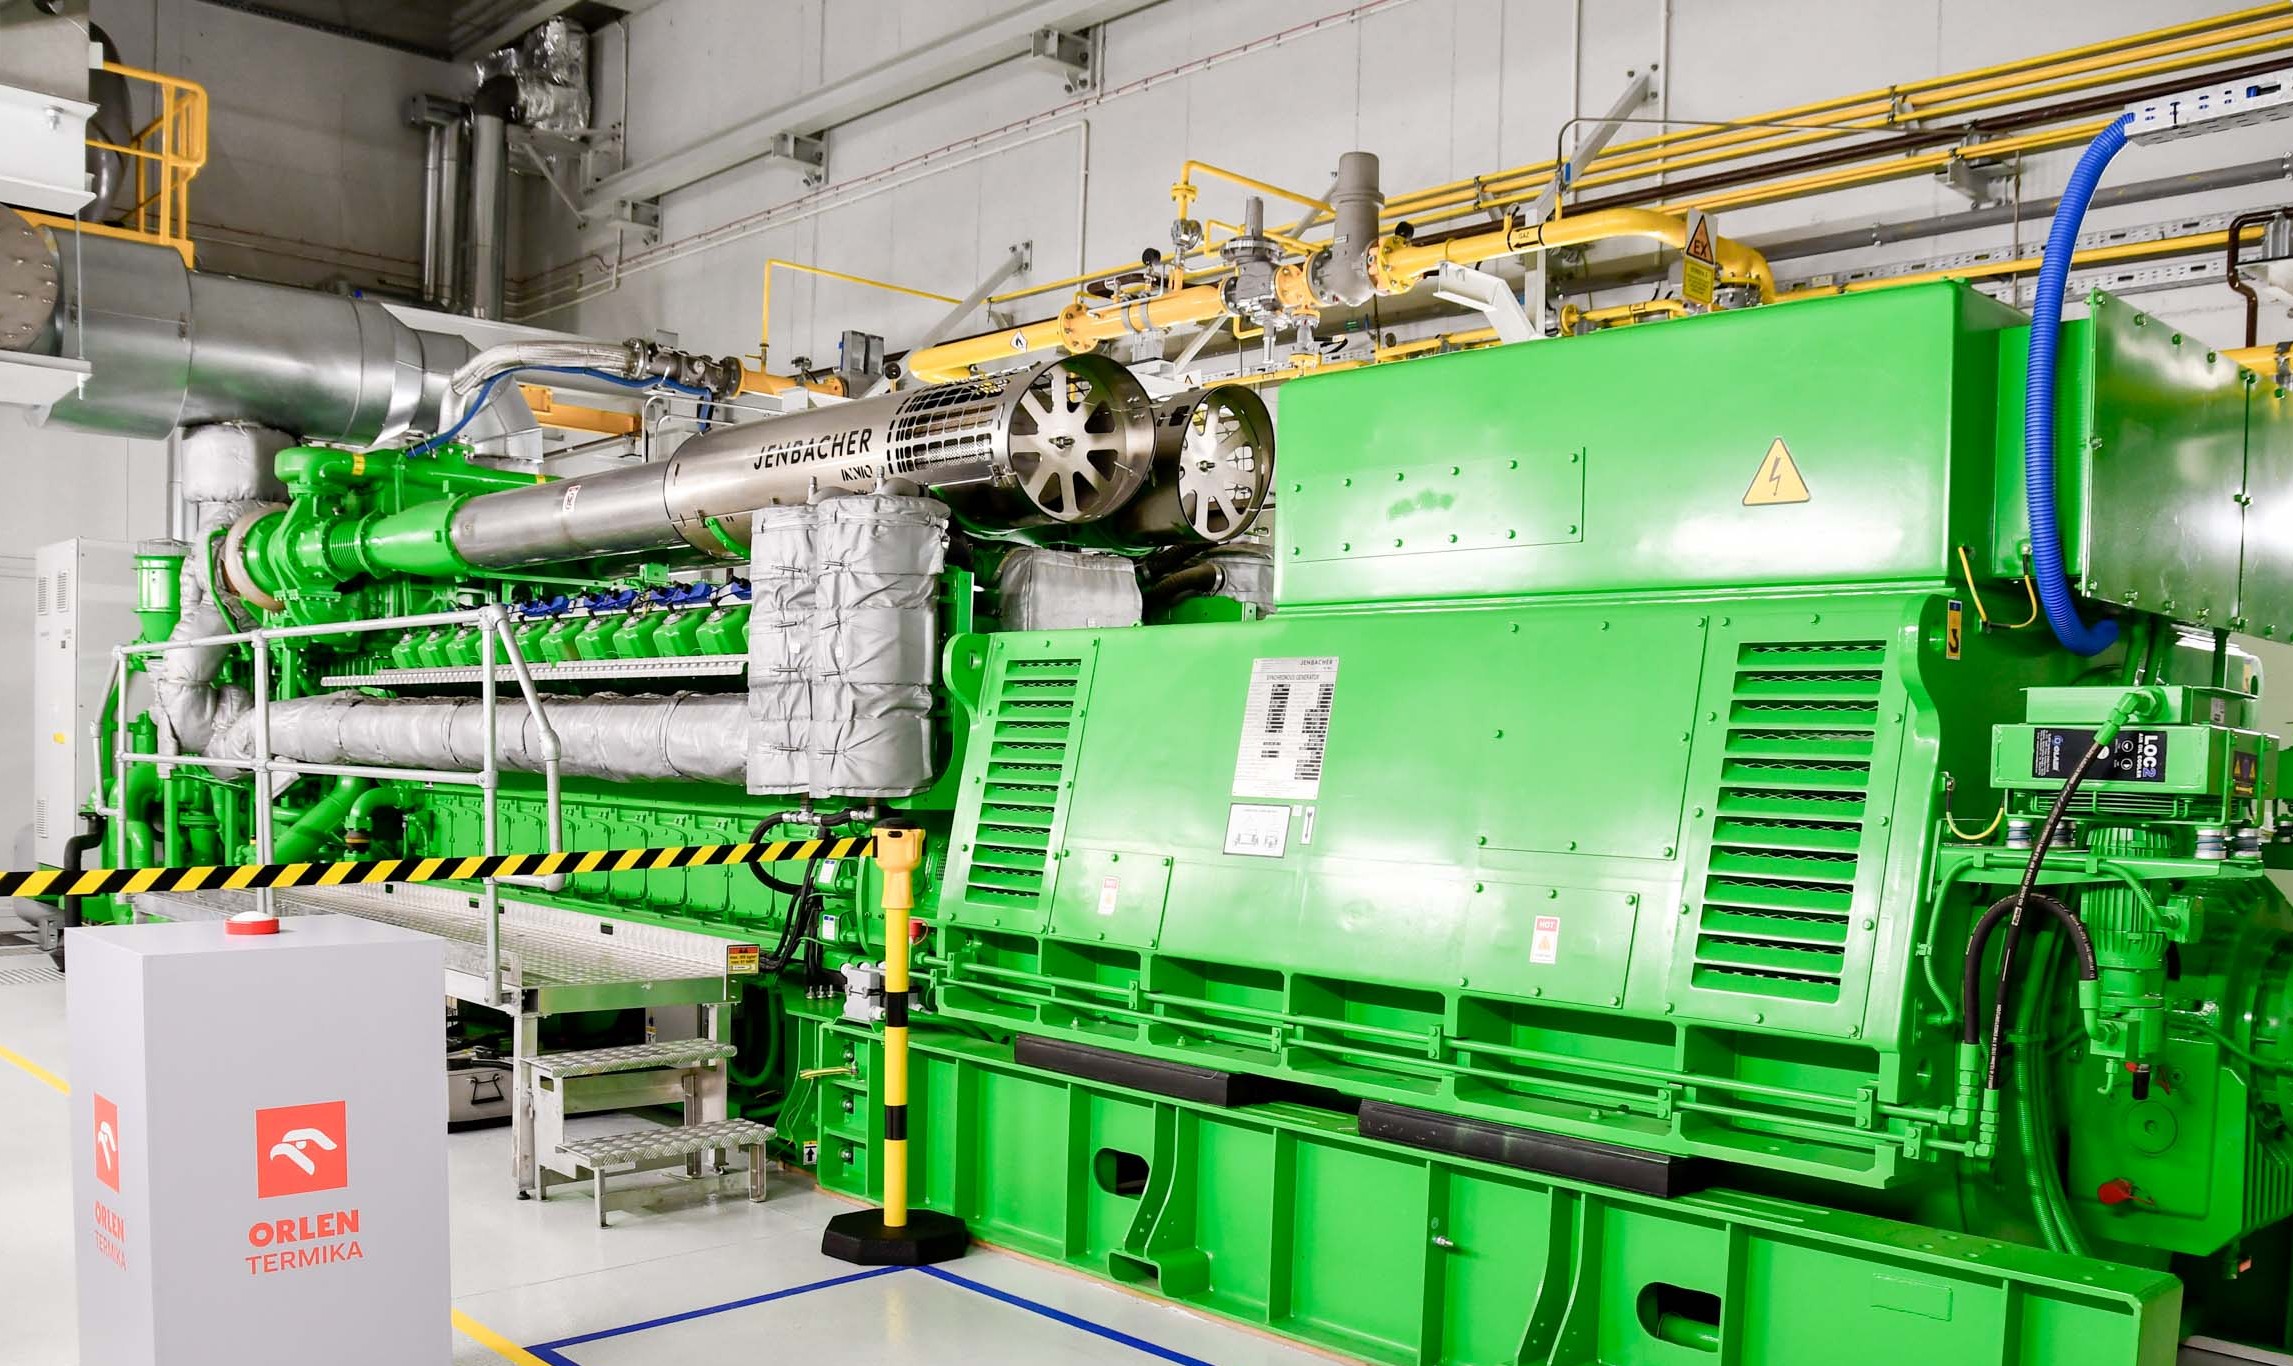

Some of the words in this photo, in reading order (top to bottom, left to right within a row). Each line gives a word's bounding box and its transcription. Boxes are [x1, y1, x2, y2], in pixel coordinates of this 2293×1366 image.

[1518, 231, 1530, 239] GAZ
[1693, 240, 1708, 258] EX
[753, 428, 873, 470] JENBACHER
[1296, 673, 1319, 681] GENERATOR
[2143, 735, 2158, 778] LOC2
[95, 1200, 124, 1243] ORLEN
[248, 1209, 359, 1248] ORLEN
[95, 1229, 126, 1272] TERMIKA
[245, 1241, 363, 1275] TERMIKA
